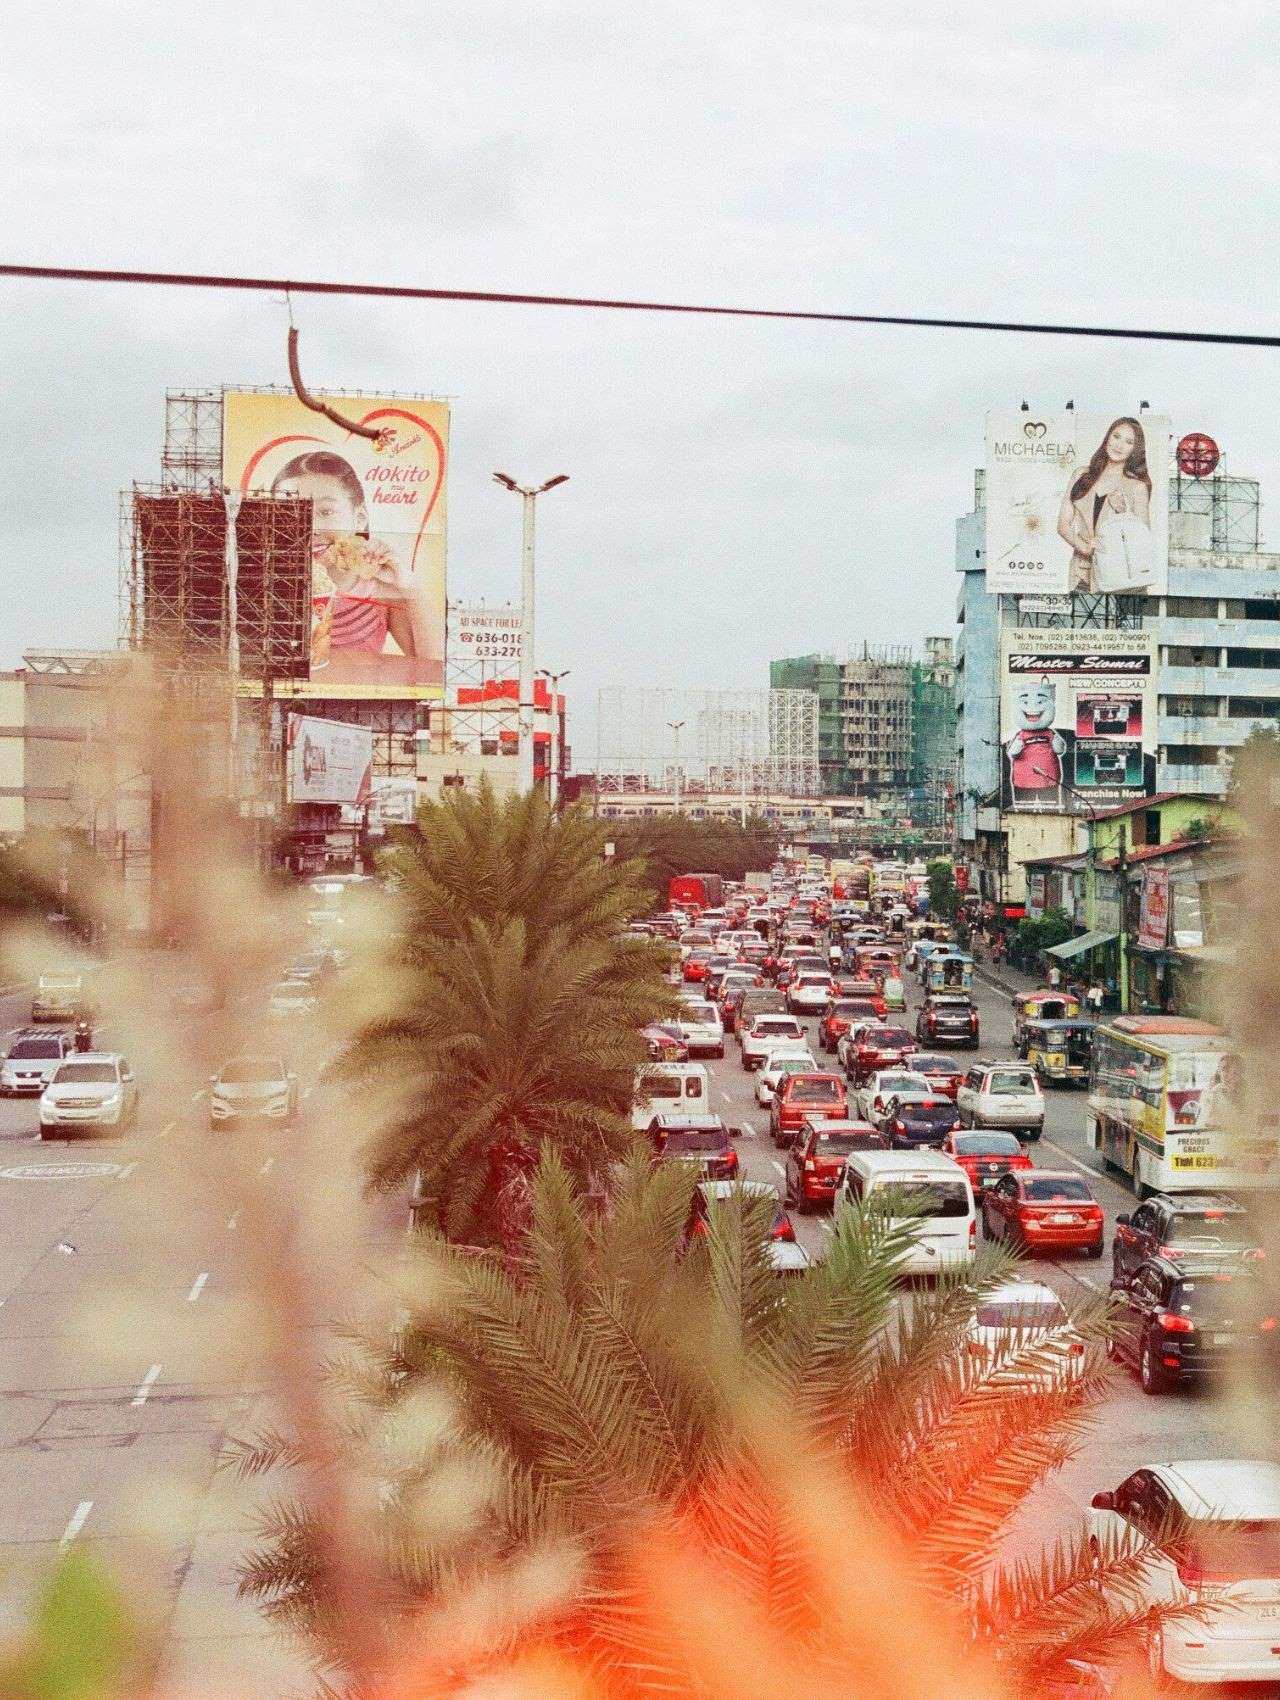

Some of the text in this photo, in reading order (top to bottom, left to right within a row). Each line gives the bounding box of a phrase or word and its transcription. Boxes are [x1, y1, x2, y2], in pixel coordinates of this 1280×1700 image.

[994, 442, 1076, 456] MICHAELA
[365, 465, 430, 482] dokito
[373, 486, 418, 504] heart
[1010, 655, 1145, 669] Master Siomai
[1121, 789, 1147, 798] Now!
